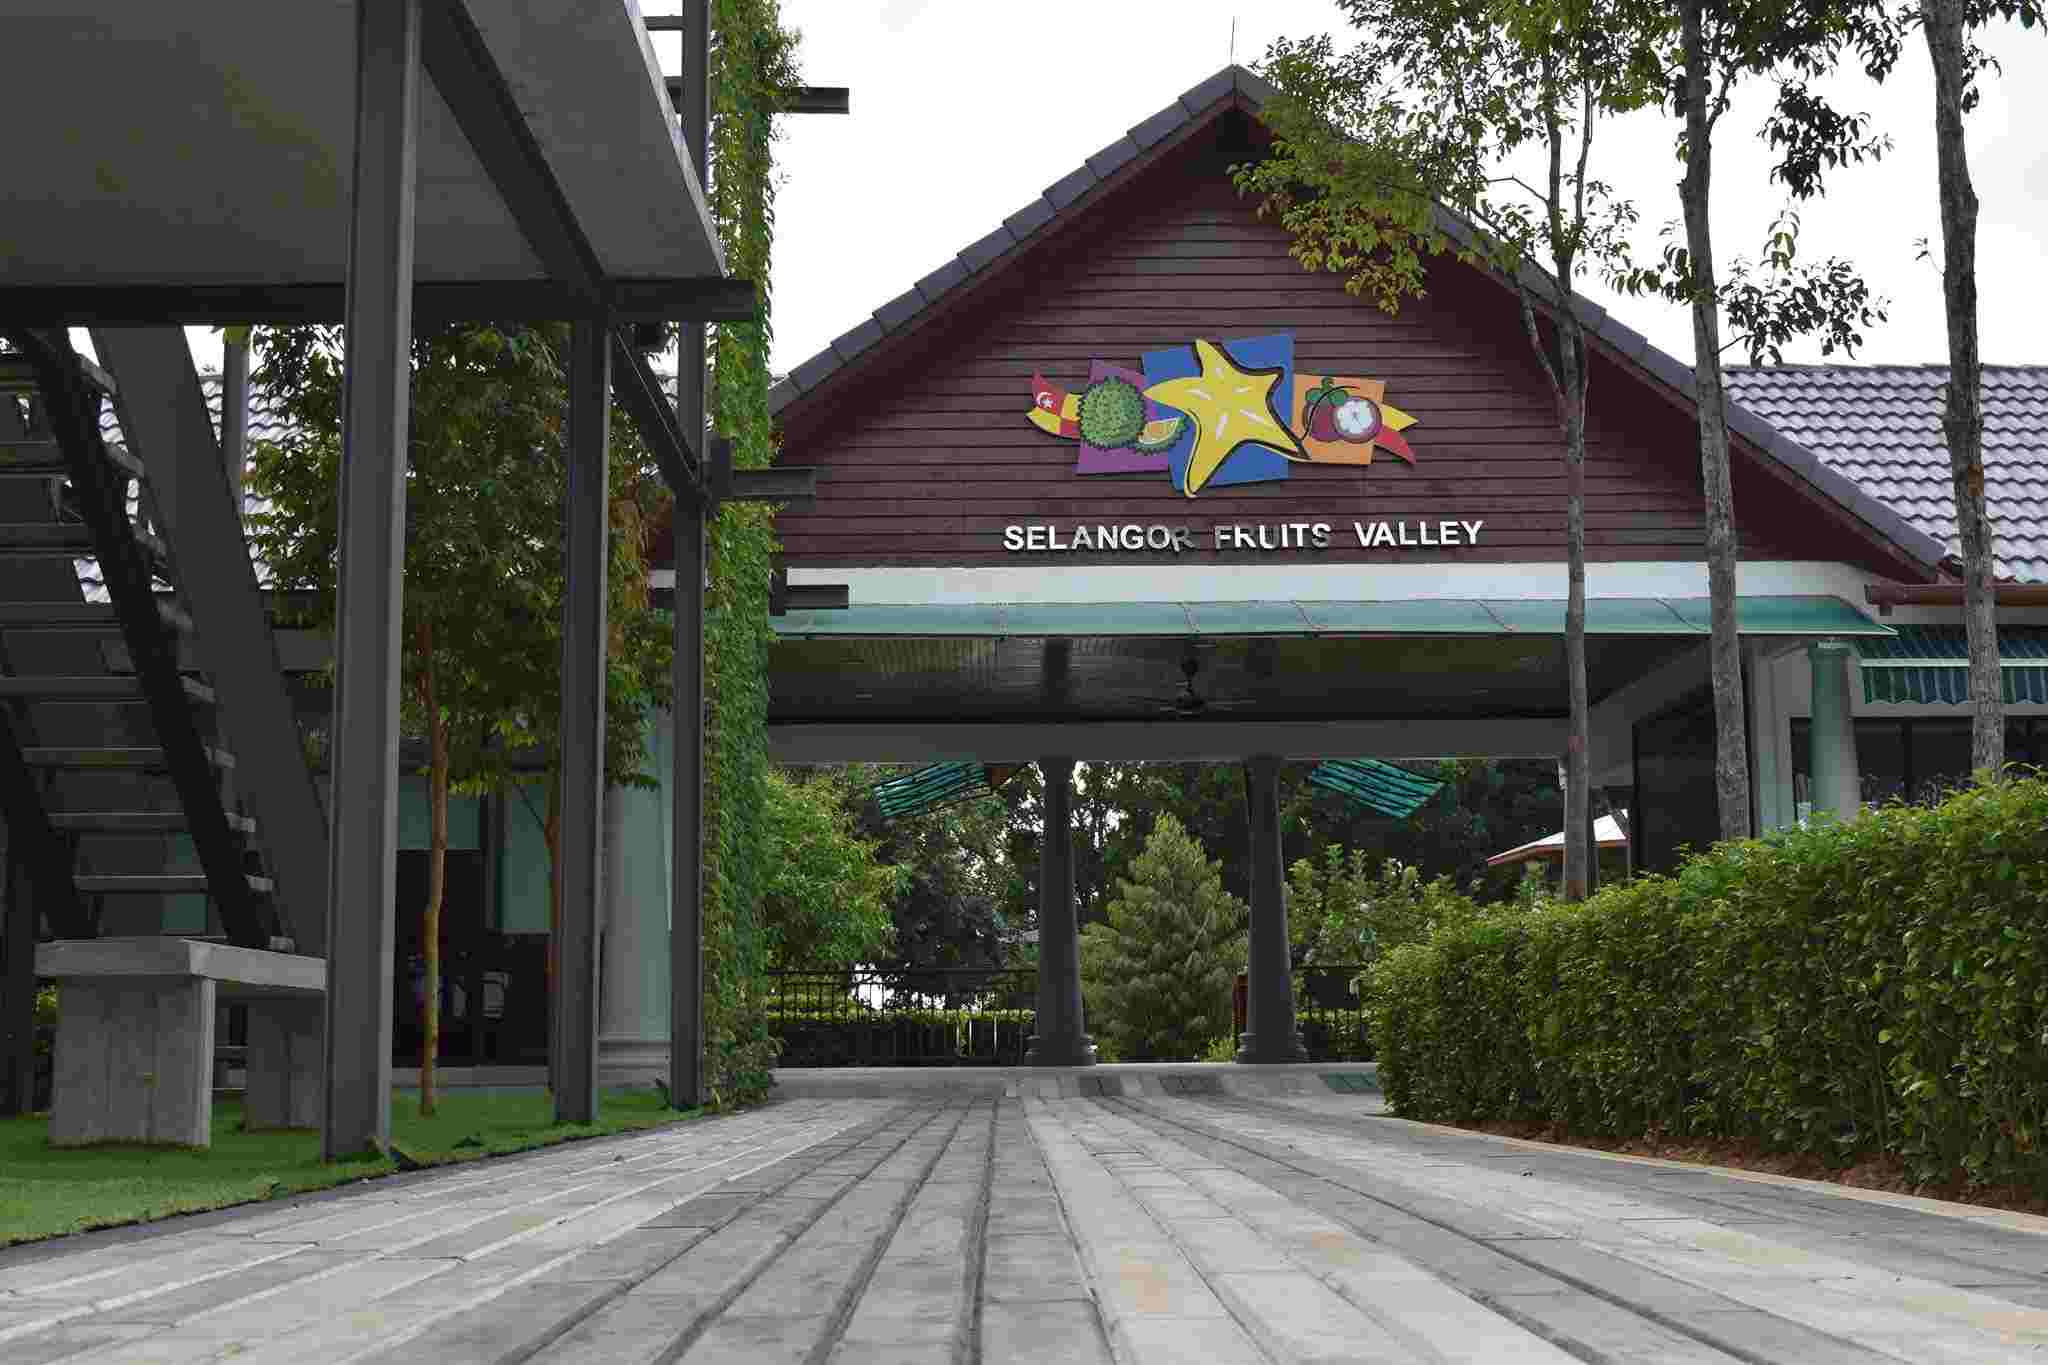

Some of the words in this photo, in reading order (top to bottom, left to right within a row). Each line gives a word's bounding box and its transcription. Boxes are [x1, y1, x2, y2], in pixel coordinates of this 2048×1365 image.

[1003, 525, 1196, 552] SELANGOR
[1214, 523, 1333, 550] FRUITS
[1354, 520, 1484, 547] VALLEY
